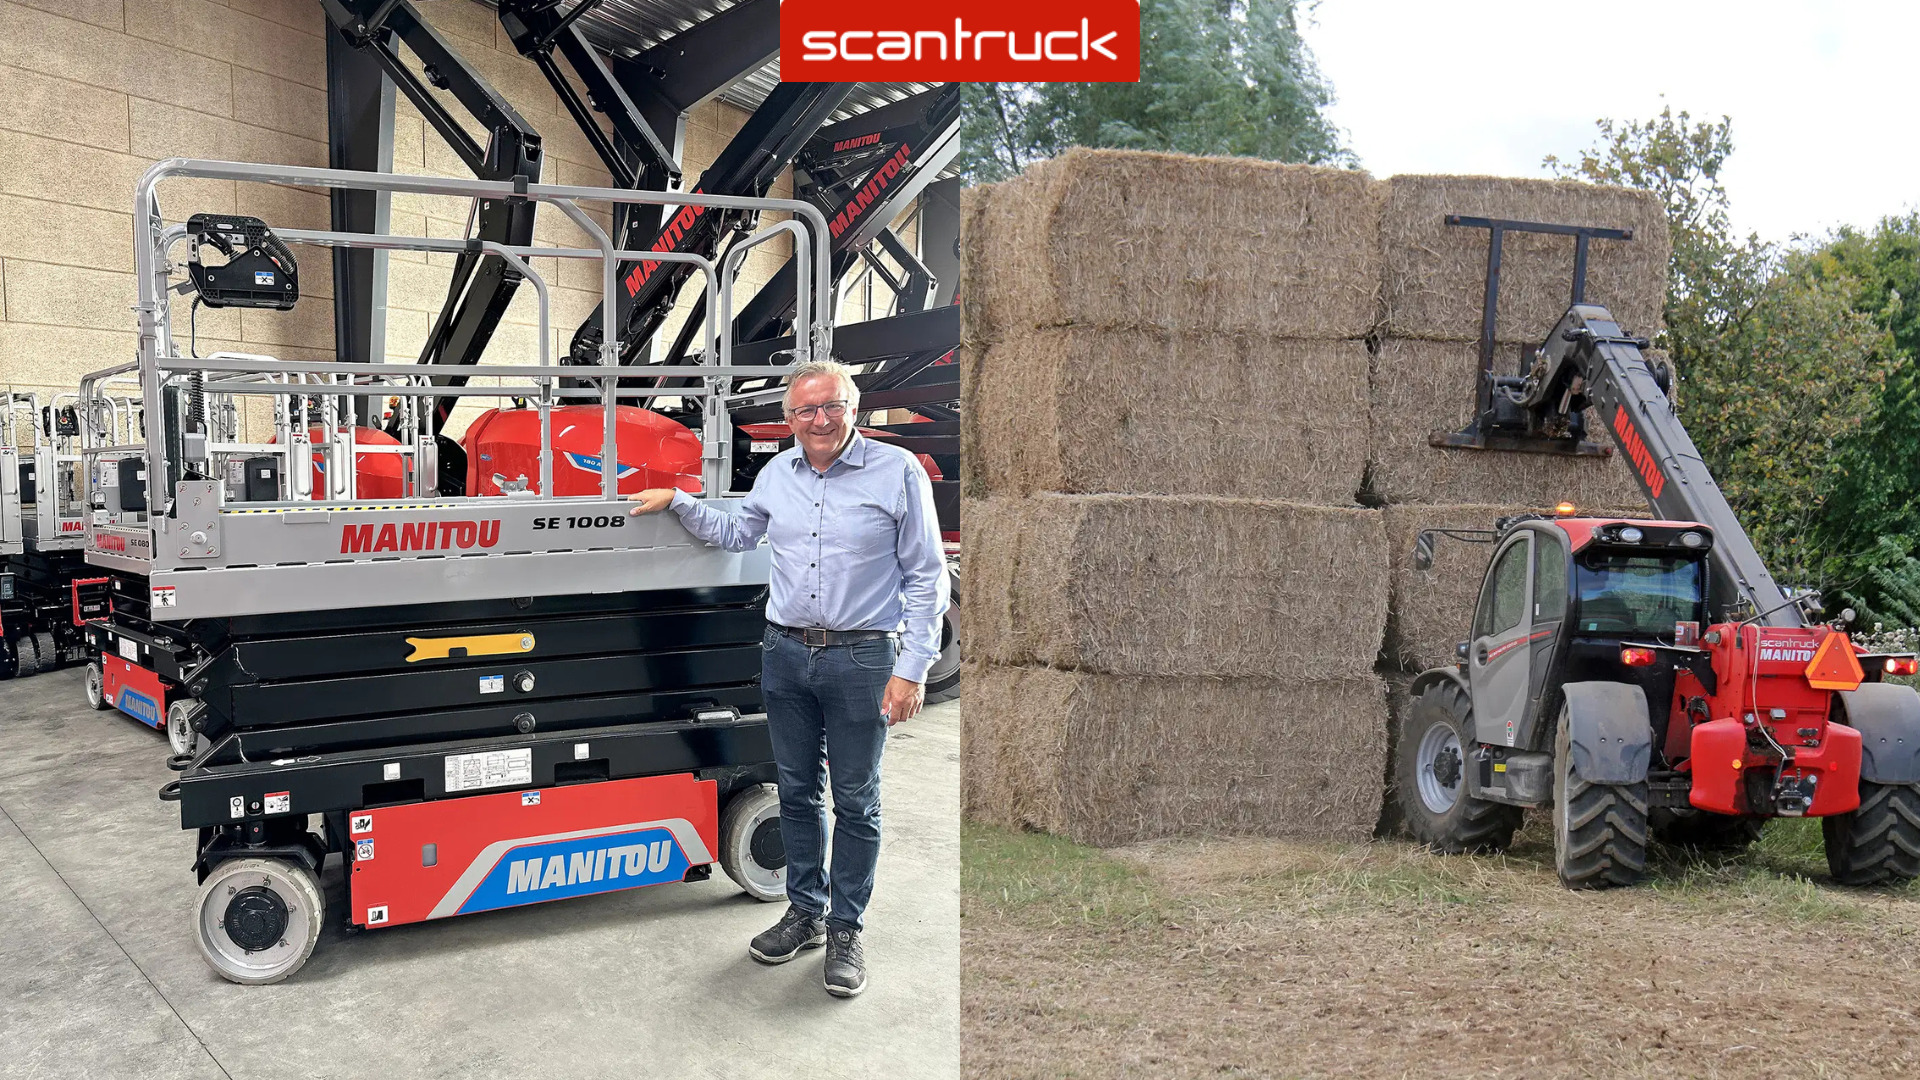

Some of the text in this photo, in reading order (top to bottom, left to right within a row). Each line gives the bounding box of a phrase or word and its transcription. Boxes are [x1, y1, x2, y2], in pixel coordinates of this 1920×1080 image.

[833, 132, 881, 152] MANITOU
[828, 142, 911, 239] MANITOU
[1613, 404, 1665, 499] MANITOU
[532, 515, 625, 530] SE 1008
[96, 533, 125, 552] MANITOU
[130, 538, 138, 547] SE
[340, 519, 501, 554] MANITOU
[1761, 638, 1819, 649] scantruck
[125, 694, 156, 721] MANITOU
[506, 839, 672, 895] MANITOU
